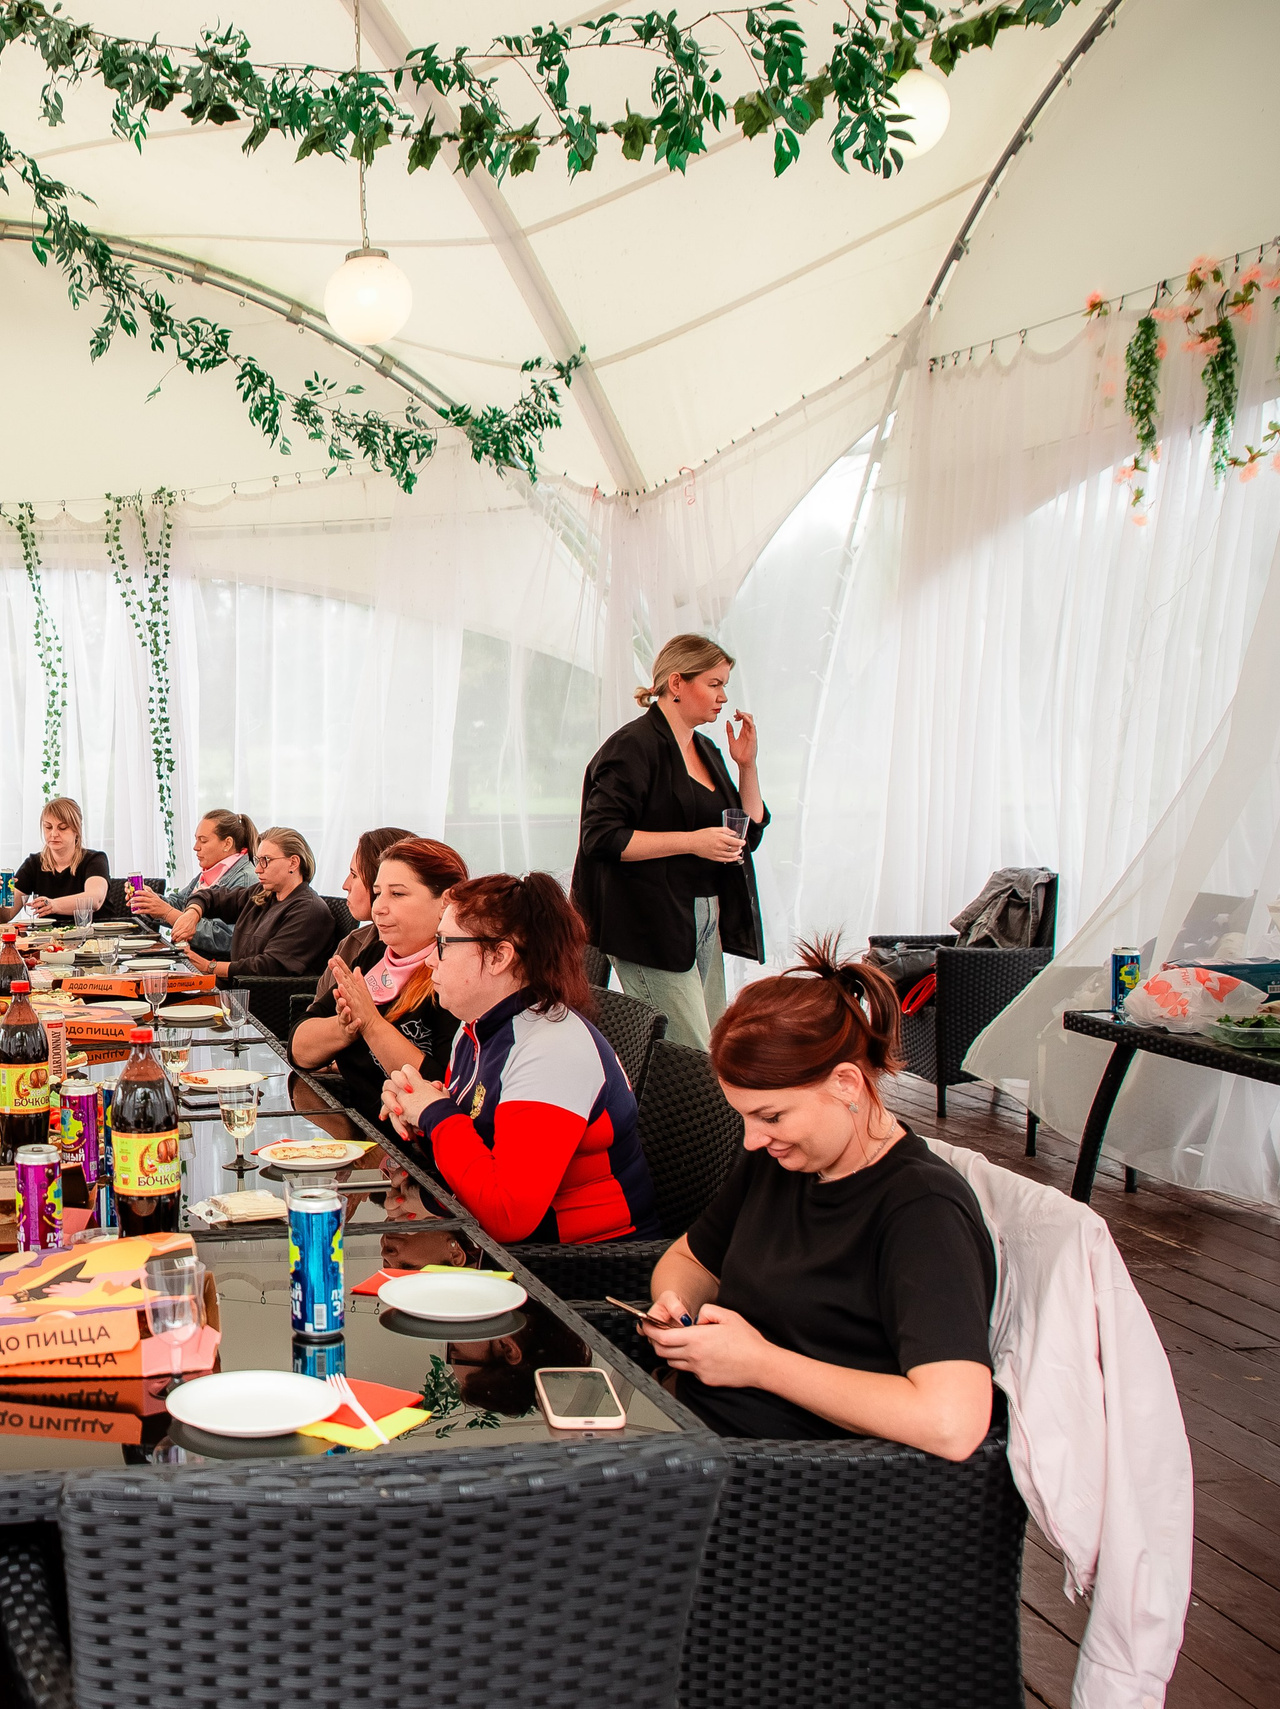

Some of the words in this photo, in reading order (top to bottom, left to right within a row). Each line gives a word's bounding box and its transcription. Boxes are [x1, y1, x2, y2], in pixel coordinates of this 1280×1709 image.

[68, 982, 87, 990] ДОДО
[88, 983, 113, 991] ПИЦЦА
[86, 1027, 125, 1038] ПИЦЦА
[51, 1031, 62, 1076] HARDONNAY
[14, 1095, 50, 1107] БОЧКОВ
[137, 1171, 180, 1187] БОЧКОВ
[26, 1325, 111, 1349] ПИЦЦА
